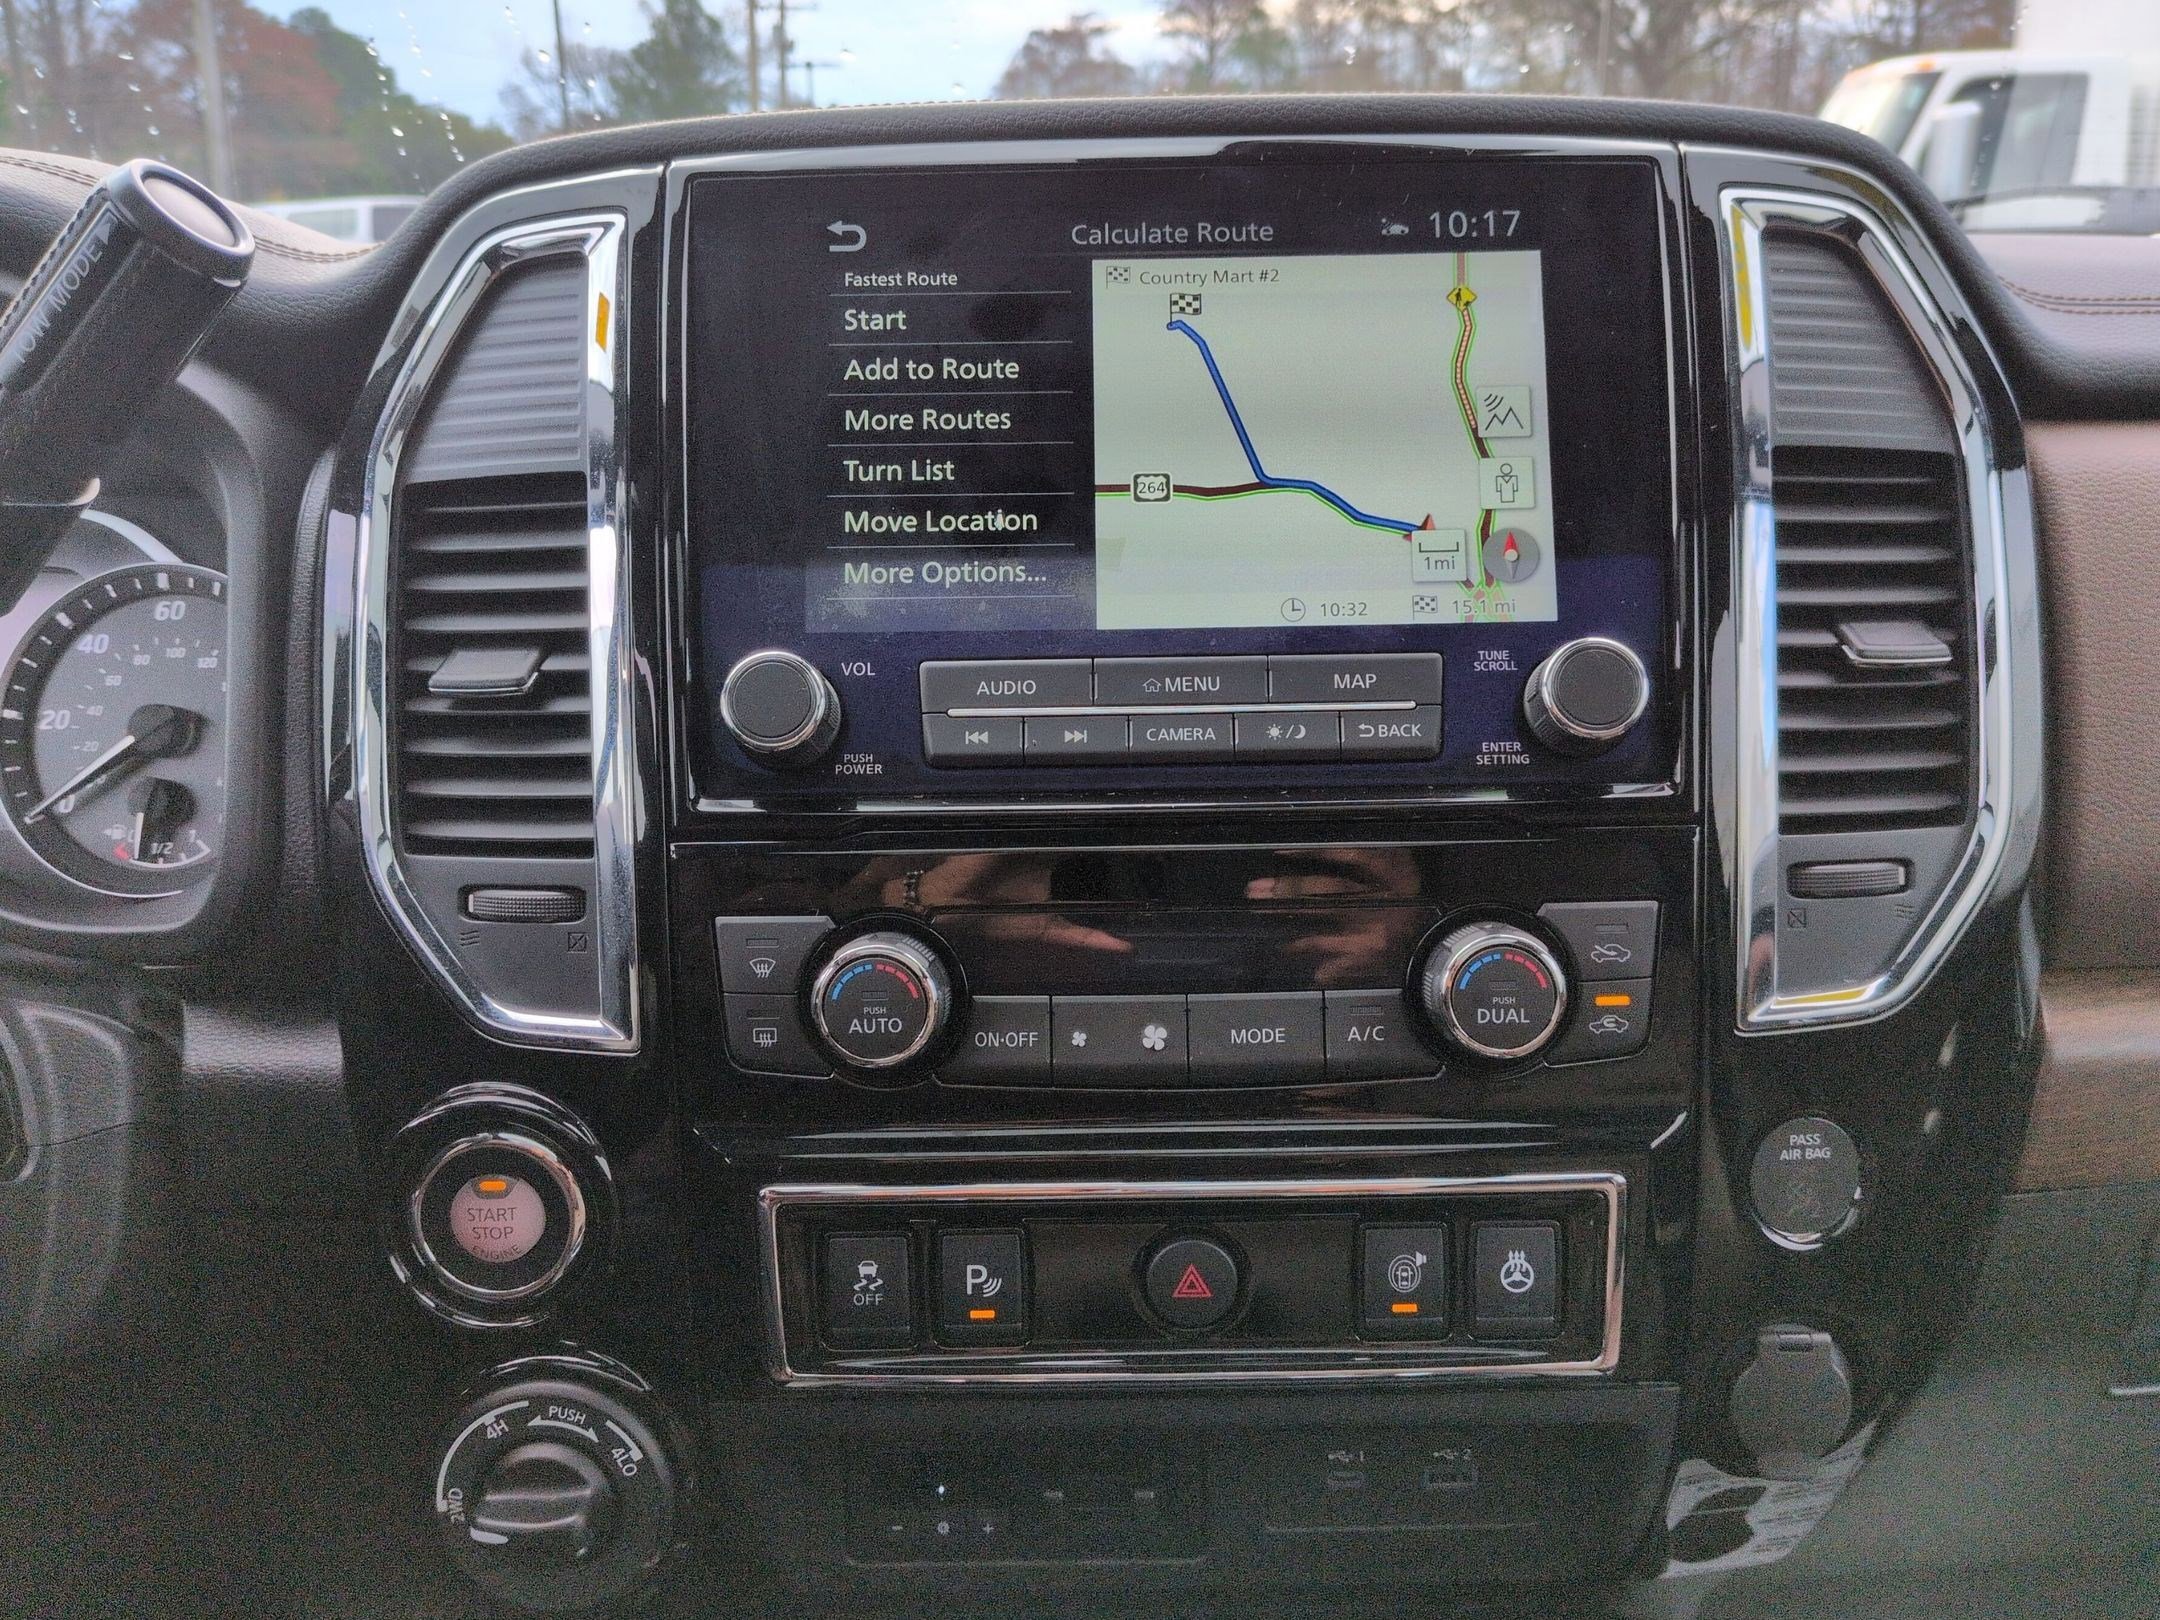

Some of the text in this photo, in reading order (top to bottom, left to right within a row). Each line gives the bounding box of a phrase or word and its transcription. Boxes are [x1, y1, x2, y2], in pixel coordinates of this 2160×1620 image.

[1428, 209, 1522, 239] 10:17
[1070, 221, 1274, 246] Calculate Route
[49, 237, 103, 312] MODE
[843, 271, 958, 288] Fastest Route
[1139, 267, 1281, 288] Country Mart #2
[843, 309, 907, 331] Start
[843, 357, 1020, 381] Add to Route
[844, 408, 1012, 431] More Routes
[842, 459, 955, 482] Turn List
[1137, 479, 1166, 495] 264
[843, 509, 1038, 533] Move Location
[843, 561, 1047, 588] More Options...
[154, 600, 186, 621] 60
[1320, 602, 1368, 617] 10:32
[1452, 598, 1517, 615] 15.1 mi
[78, 634, 110, 655] 40
[1477, 650, 1510, 662] TUNE
[841, 661, 876, 677] VOL
[1472, 661, 1518, 672] SCROLL
[976, 679, 1037, 696] AUDIO
[1164, 676, 1221, 693] MENU
[1333, 673, 1377, 690] MAP
[37, 710, 71, 730] 20
[1146, 727, 1216, 742] CAMERA
[1378, 723, 1422, 738] BACK
[1481, 741, 1523, 753] ENTER
[843, 753, 874, 764] PUSH
[1476, 753, 1530, 766] SETTING
[834, 764, 883, 775] POWER
[1493, 996, 1516, 1005] PUSH
[863, 1006, 887, 1015] PUSH
[1477, 1008, 1530, 1025] DUAL
[849, 1018, 903, 1035] AUTO
[1347, 1026, 1385, 1041] A/C
[1230, 1028, 1286, 1044] MODE
[1789, 1134, 1821, 1146] PASS
[1780, 1147, 1831, 1161] AIR BAG
[467, 1207, 518, 1222] START
[472, 1227, 514, 1240] STOP
[472, 1244, 521, 1260] ENGINE
[853, 1294, 884, 1306] OFF
[549, 1405, 586, 1425] PUSH
[486, 1419, 509, 1440] 4H
[611, 1447, 638, 1478] 4LO
